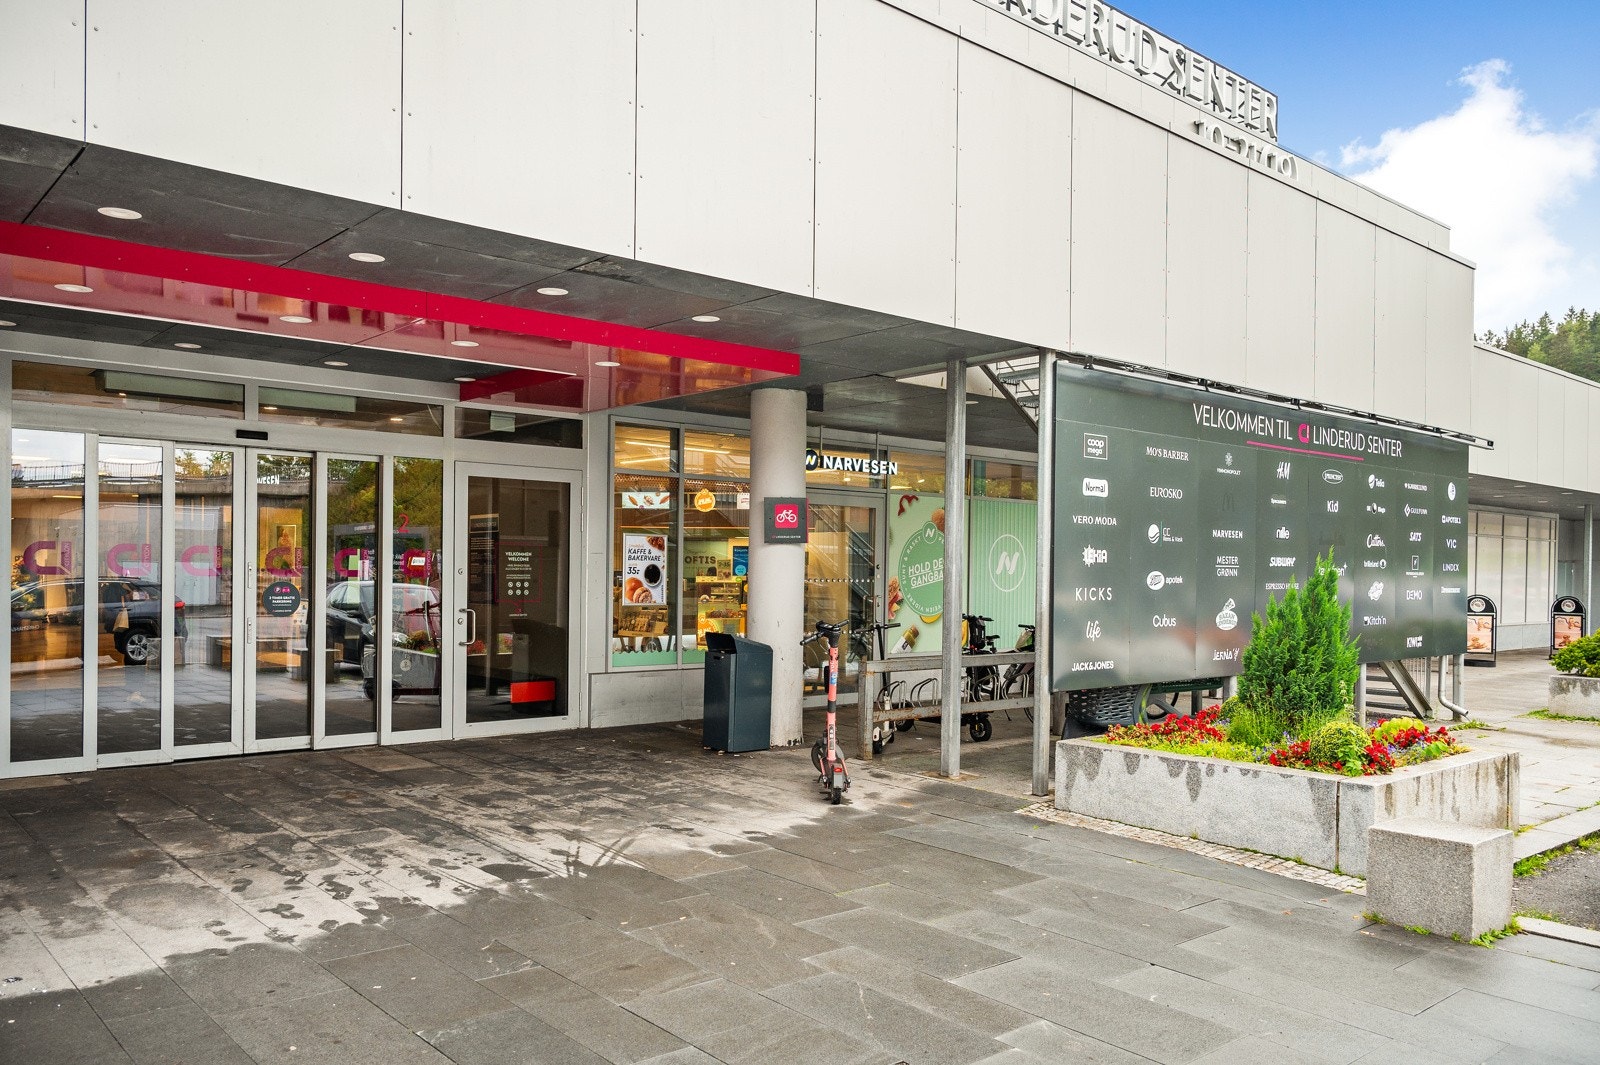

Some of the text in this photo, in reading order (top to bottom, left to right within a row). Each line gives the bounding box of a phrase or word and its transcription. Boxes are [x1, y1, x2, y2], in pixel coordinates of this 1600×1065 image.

[1168, 46, 1278, 142] SENTER
[1192, 403, 1273, 437] VELKOMMEN
[1276, 420, 1293, 440] TIL
[1313, 427, 1365, 451] LINDERUD
[1367, 436, 1402, 457] SENTER
[1087, 438, 1104, 448] coop
[1163, 449, 1189, 461] BARBER
[823, 455, 897, 475] NARVESEN
[1085, 482, 1106, 493] Normal
[1150, 486, 1183, 499] EUROSKO
[1327, 500, 1339, 512] Kid
[1072, 515, 1117, 526] VERO MODA
[1212, 529, 1243, 538] NARVESEN
[1409, 531, 1421, 542] SATS
[1446, 538, 1457, 548] VIC
[1216, 556, 1239, 565] MESTER
[908, 557, 945, 577] HOLD DE
[1216, 568, 1238, 577] GRØNN
[910, 570, 944, 588] GANGBA
[1075, 587, 1112, 601] KICKS
[1406, 590, 1423, 600] DEMO
[1152, 614, 1177, 628] Cubus
[1086, 620, 1102, 641] life
[1071, 660, 1114, 671] JACK&JONES
